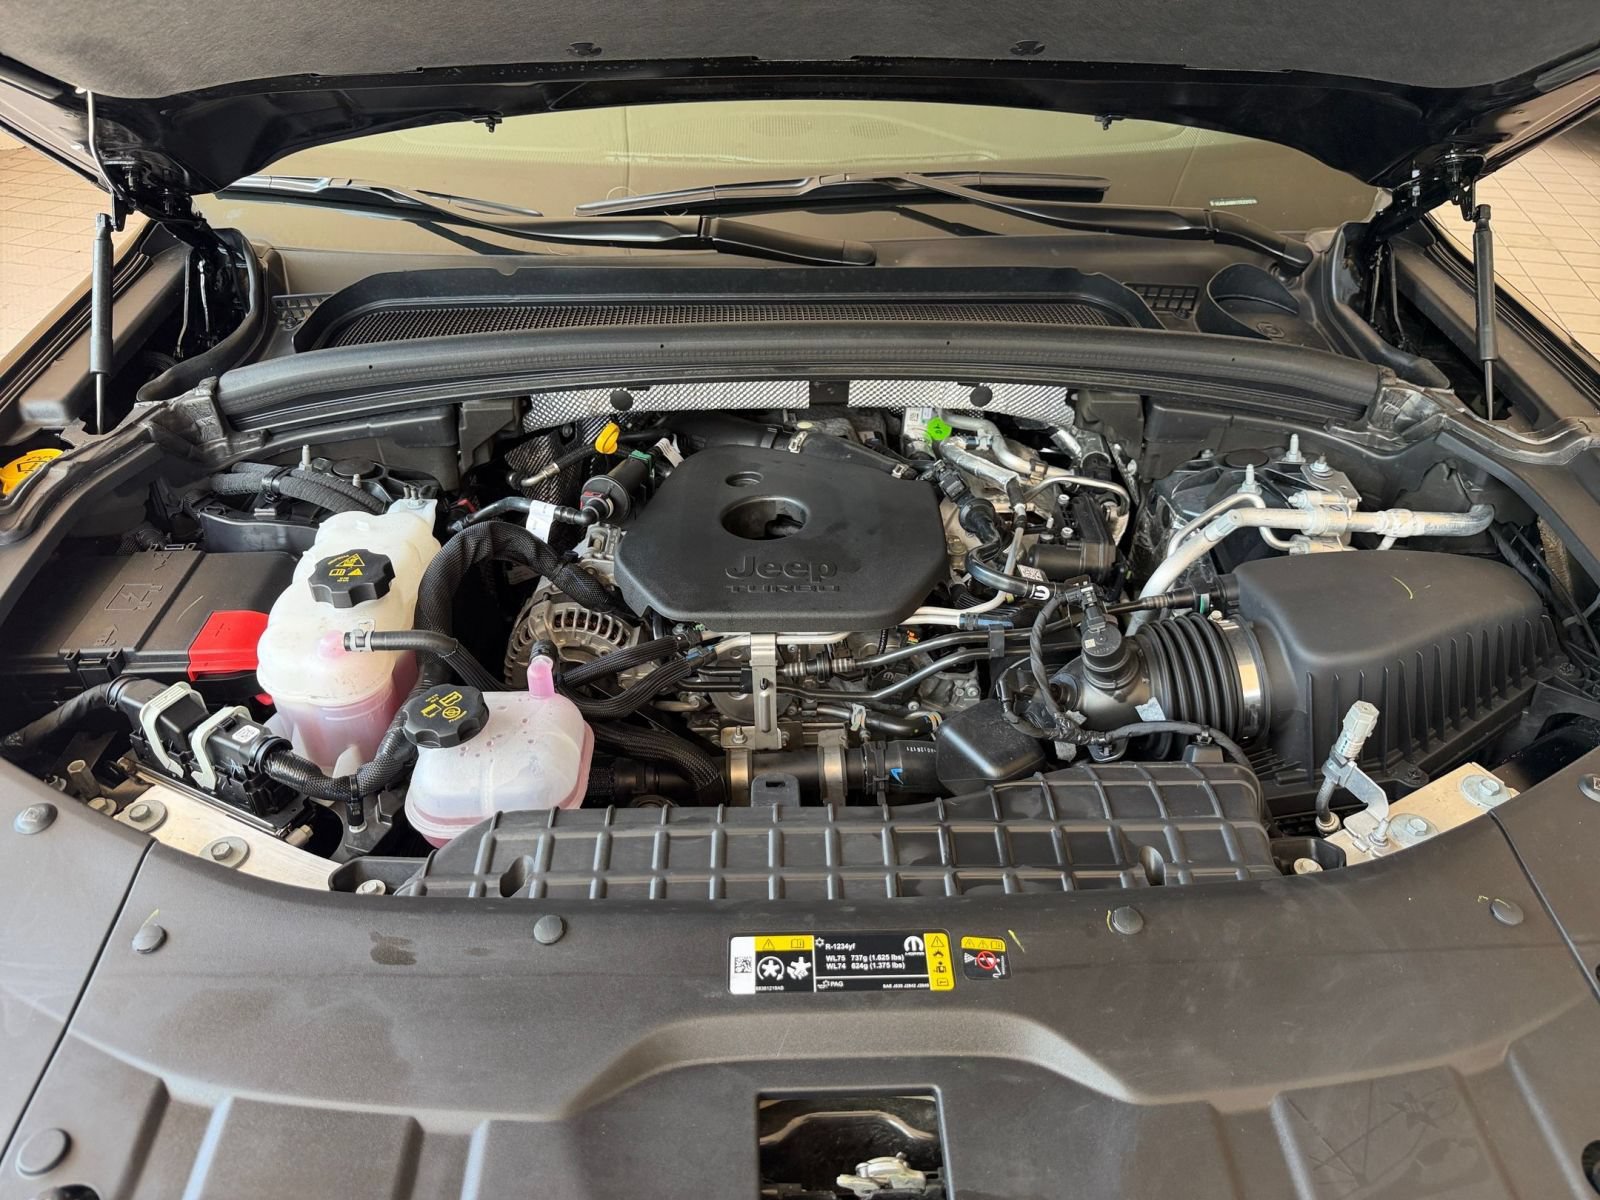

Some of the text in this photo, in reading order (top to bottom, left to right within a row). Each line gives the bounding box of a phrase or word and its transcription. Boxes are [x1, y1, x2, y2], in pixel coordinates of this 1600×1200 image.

[725, 555, 838, 583] Jeep
[850, 954, 868, 963] 737g
[891, 953, 905, 962] lbs)
[891, 961, 906, 970] lbs)
